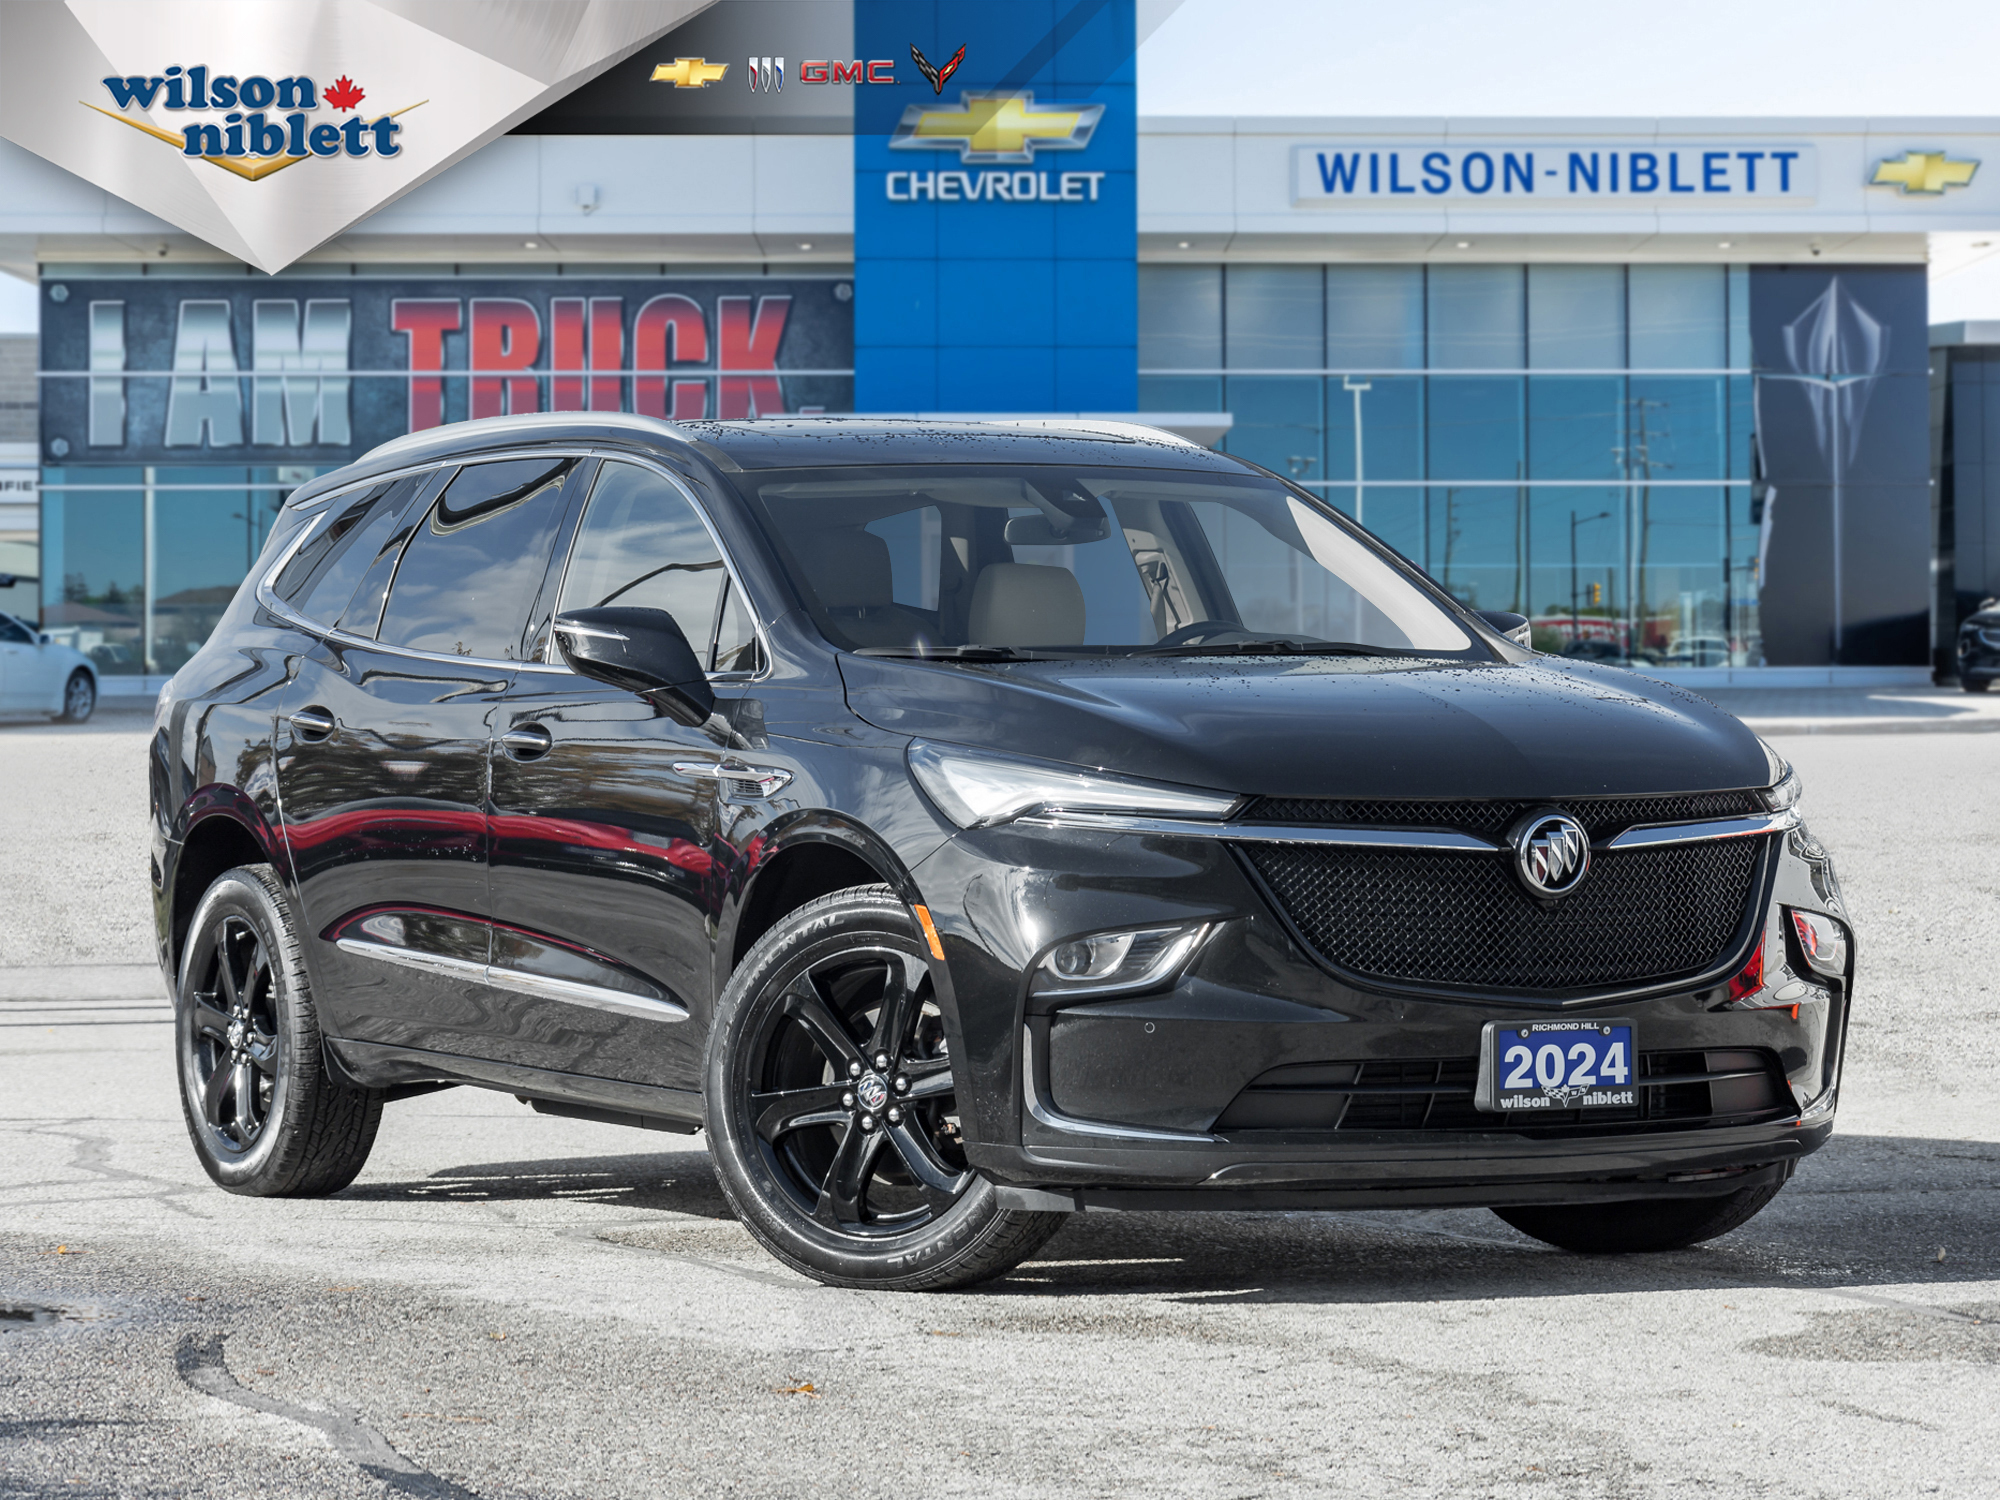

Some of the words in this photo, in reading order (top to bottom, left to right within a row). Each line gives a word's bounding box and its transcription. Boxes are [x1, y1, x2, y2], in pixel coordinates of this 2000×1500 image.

[886, 171, 1105, 200] CHEVROLET
[1316, 151, 1799, 195] WILSON-NIBLETT
[89, 300, 127, 447] I
[164, 300, 352, 447] AM
[391, 293, 793, 434] TRUCK
[1532, 1023, 1579, 1032] RICHMOND
[1581, 1022, 1599, 1030] HILL
[1504, 1042, 1628, 1089] 2024
[1500, 1094, 1550, 1108] wilson
[1582, 1091, 1633, 1105] niblett
